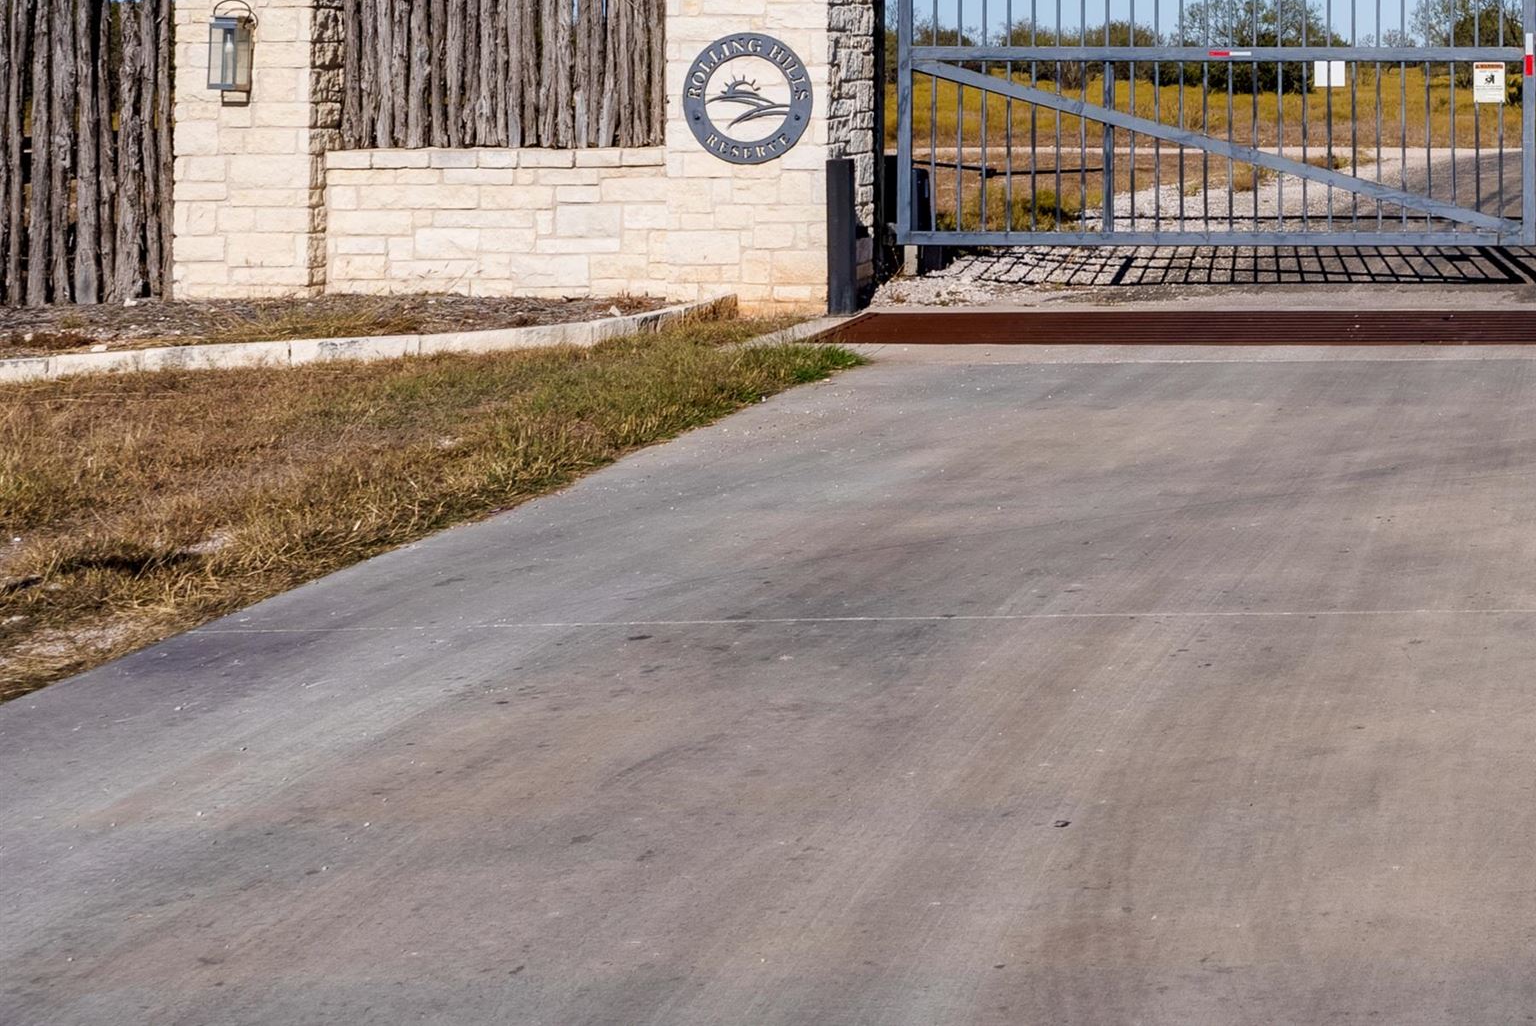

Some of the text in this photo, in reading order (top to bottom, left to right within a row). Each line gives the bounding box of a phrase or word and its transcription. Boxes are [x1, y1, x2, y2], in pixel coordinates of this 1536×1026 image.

[686, 37, 810, 101] ROLLING HILLS
[705, 132, 791, 159] RESERVE
